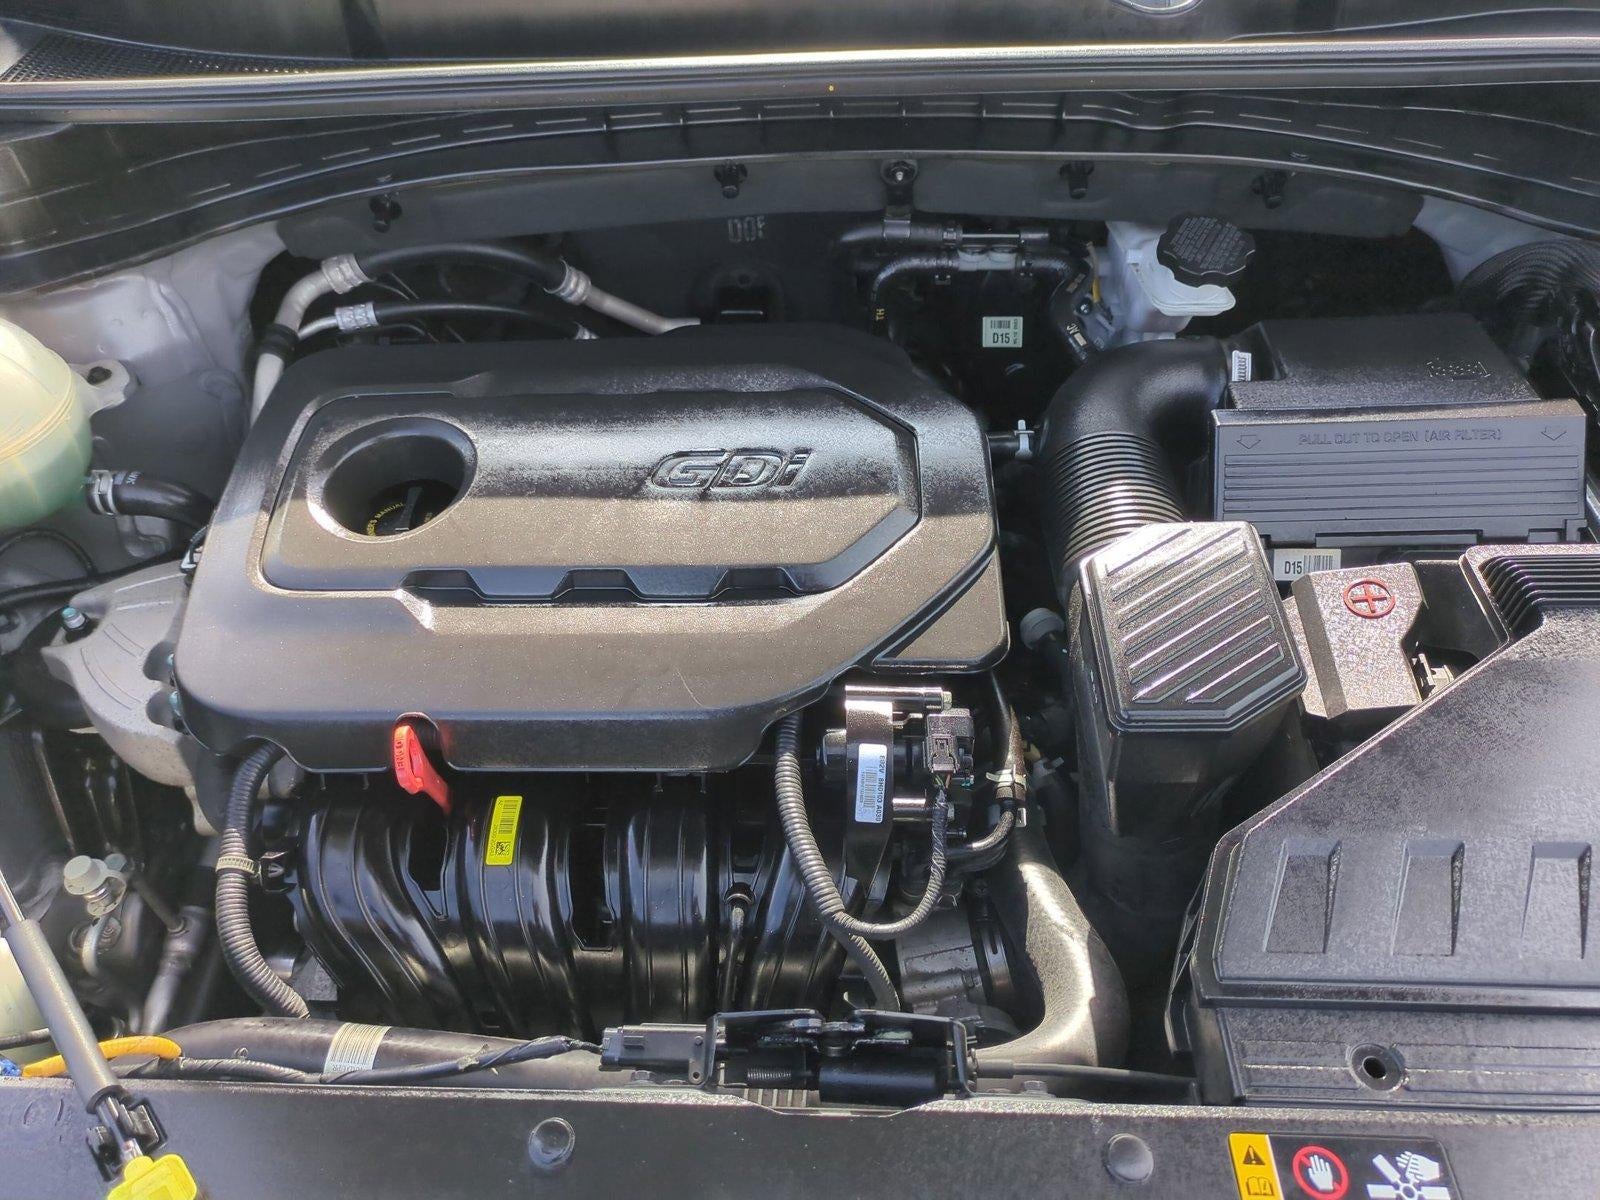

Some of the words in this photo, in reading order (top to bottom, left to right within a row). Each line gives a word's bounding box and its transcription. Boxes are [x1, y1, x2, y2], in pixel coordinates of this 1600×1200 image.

[993, 332, 1010, 344] D15
[1299, 434, 1332, 445] PULL
[1334, 432, 1358, 444] OUT
[1364, 431, 1379, 443] TO
[1384, 430, 1418, 442] OPEN
[1284, 560, 1303, 575] D15
